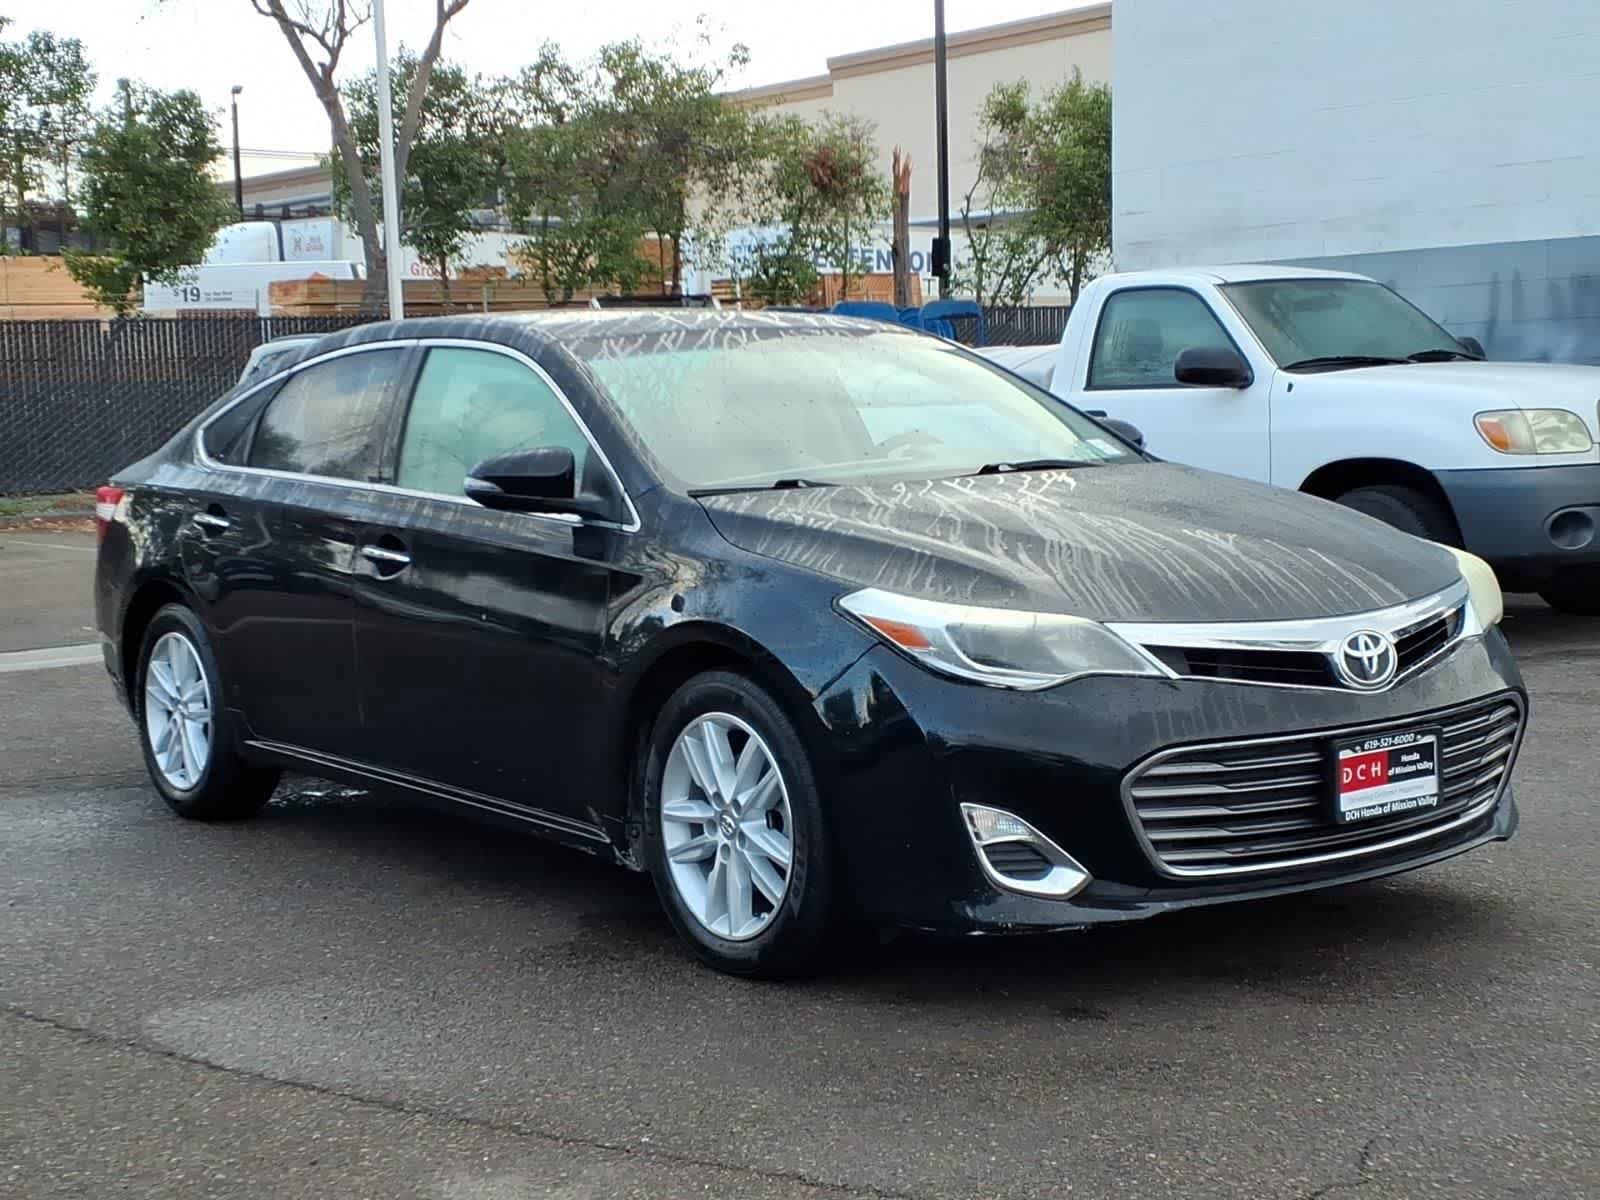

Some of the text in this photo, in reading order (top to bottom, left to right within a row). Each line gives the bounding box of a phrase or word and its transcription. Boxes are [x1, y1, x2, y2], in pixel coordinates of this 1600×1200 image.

[1364, 733, 1415, 749] 619-521-6000
[1401, 752, 1420, 762] Honda
[1343, 761, 1381, 783] DCH
[1388, 761, 1433, 776] of Mission Valley
[1345, 795, 1438, 821] DCH Honda of Mission Valley
